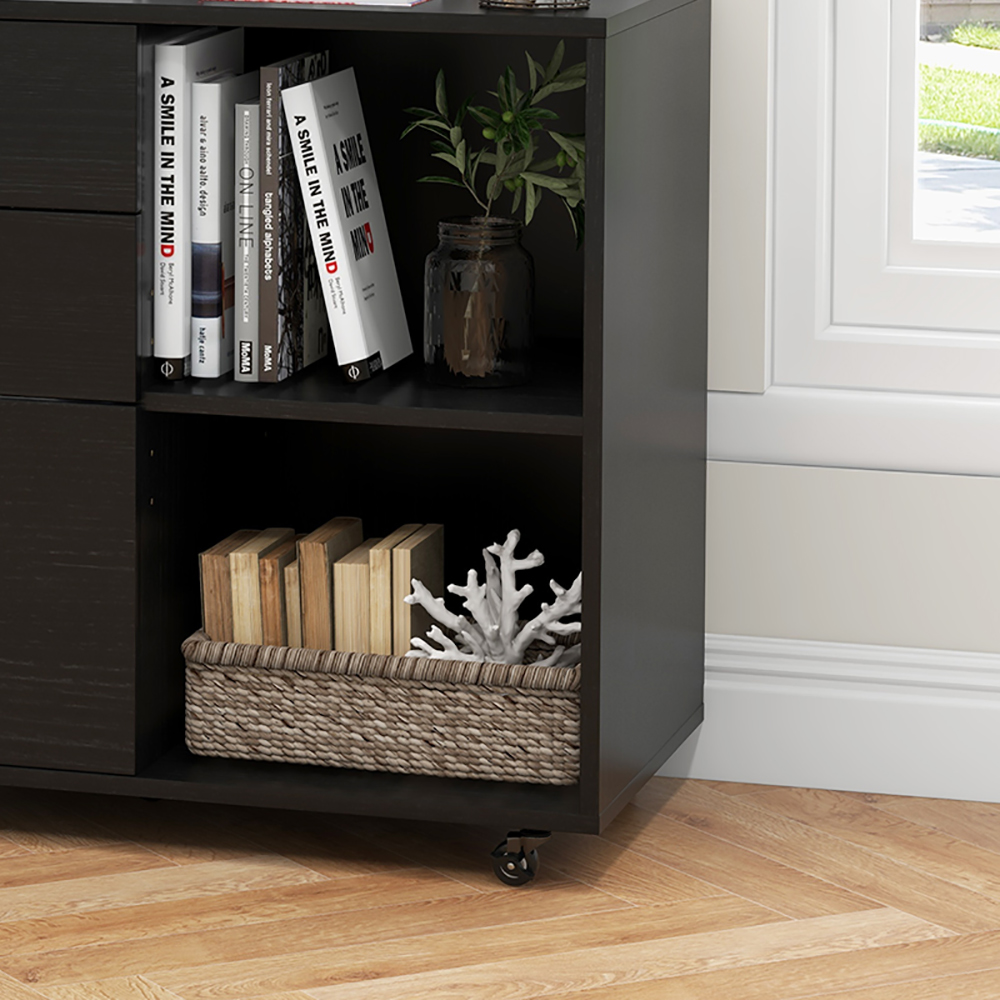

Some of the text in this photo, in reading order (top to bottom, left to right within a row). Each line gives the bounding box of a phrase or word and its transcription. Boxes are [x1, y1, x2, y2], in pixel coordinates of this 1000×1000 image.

[199, 115, 208, 137] alvar
[265, 120, 273, 131] and
[160, 76, 175, 258] A SMILE IN THE MIND
[199, 146, 209, 163] aino
[333, 132, 367, 176] A SMILE
[239, 166, 254, 194] ON
[293, 115, 338, 274] A SMILE IN THE MIND
[340, 178, 370, 219] IN THE
[238, 205, 254, 248] LINE
[262, 192, 274, 281] tangled alphabets
[350, 221, 375, 262] MIND
[241, 342, 251, 373] MoMA
[263, 344, 272, 372] MoMA
